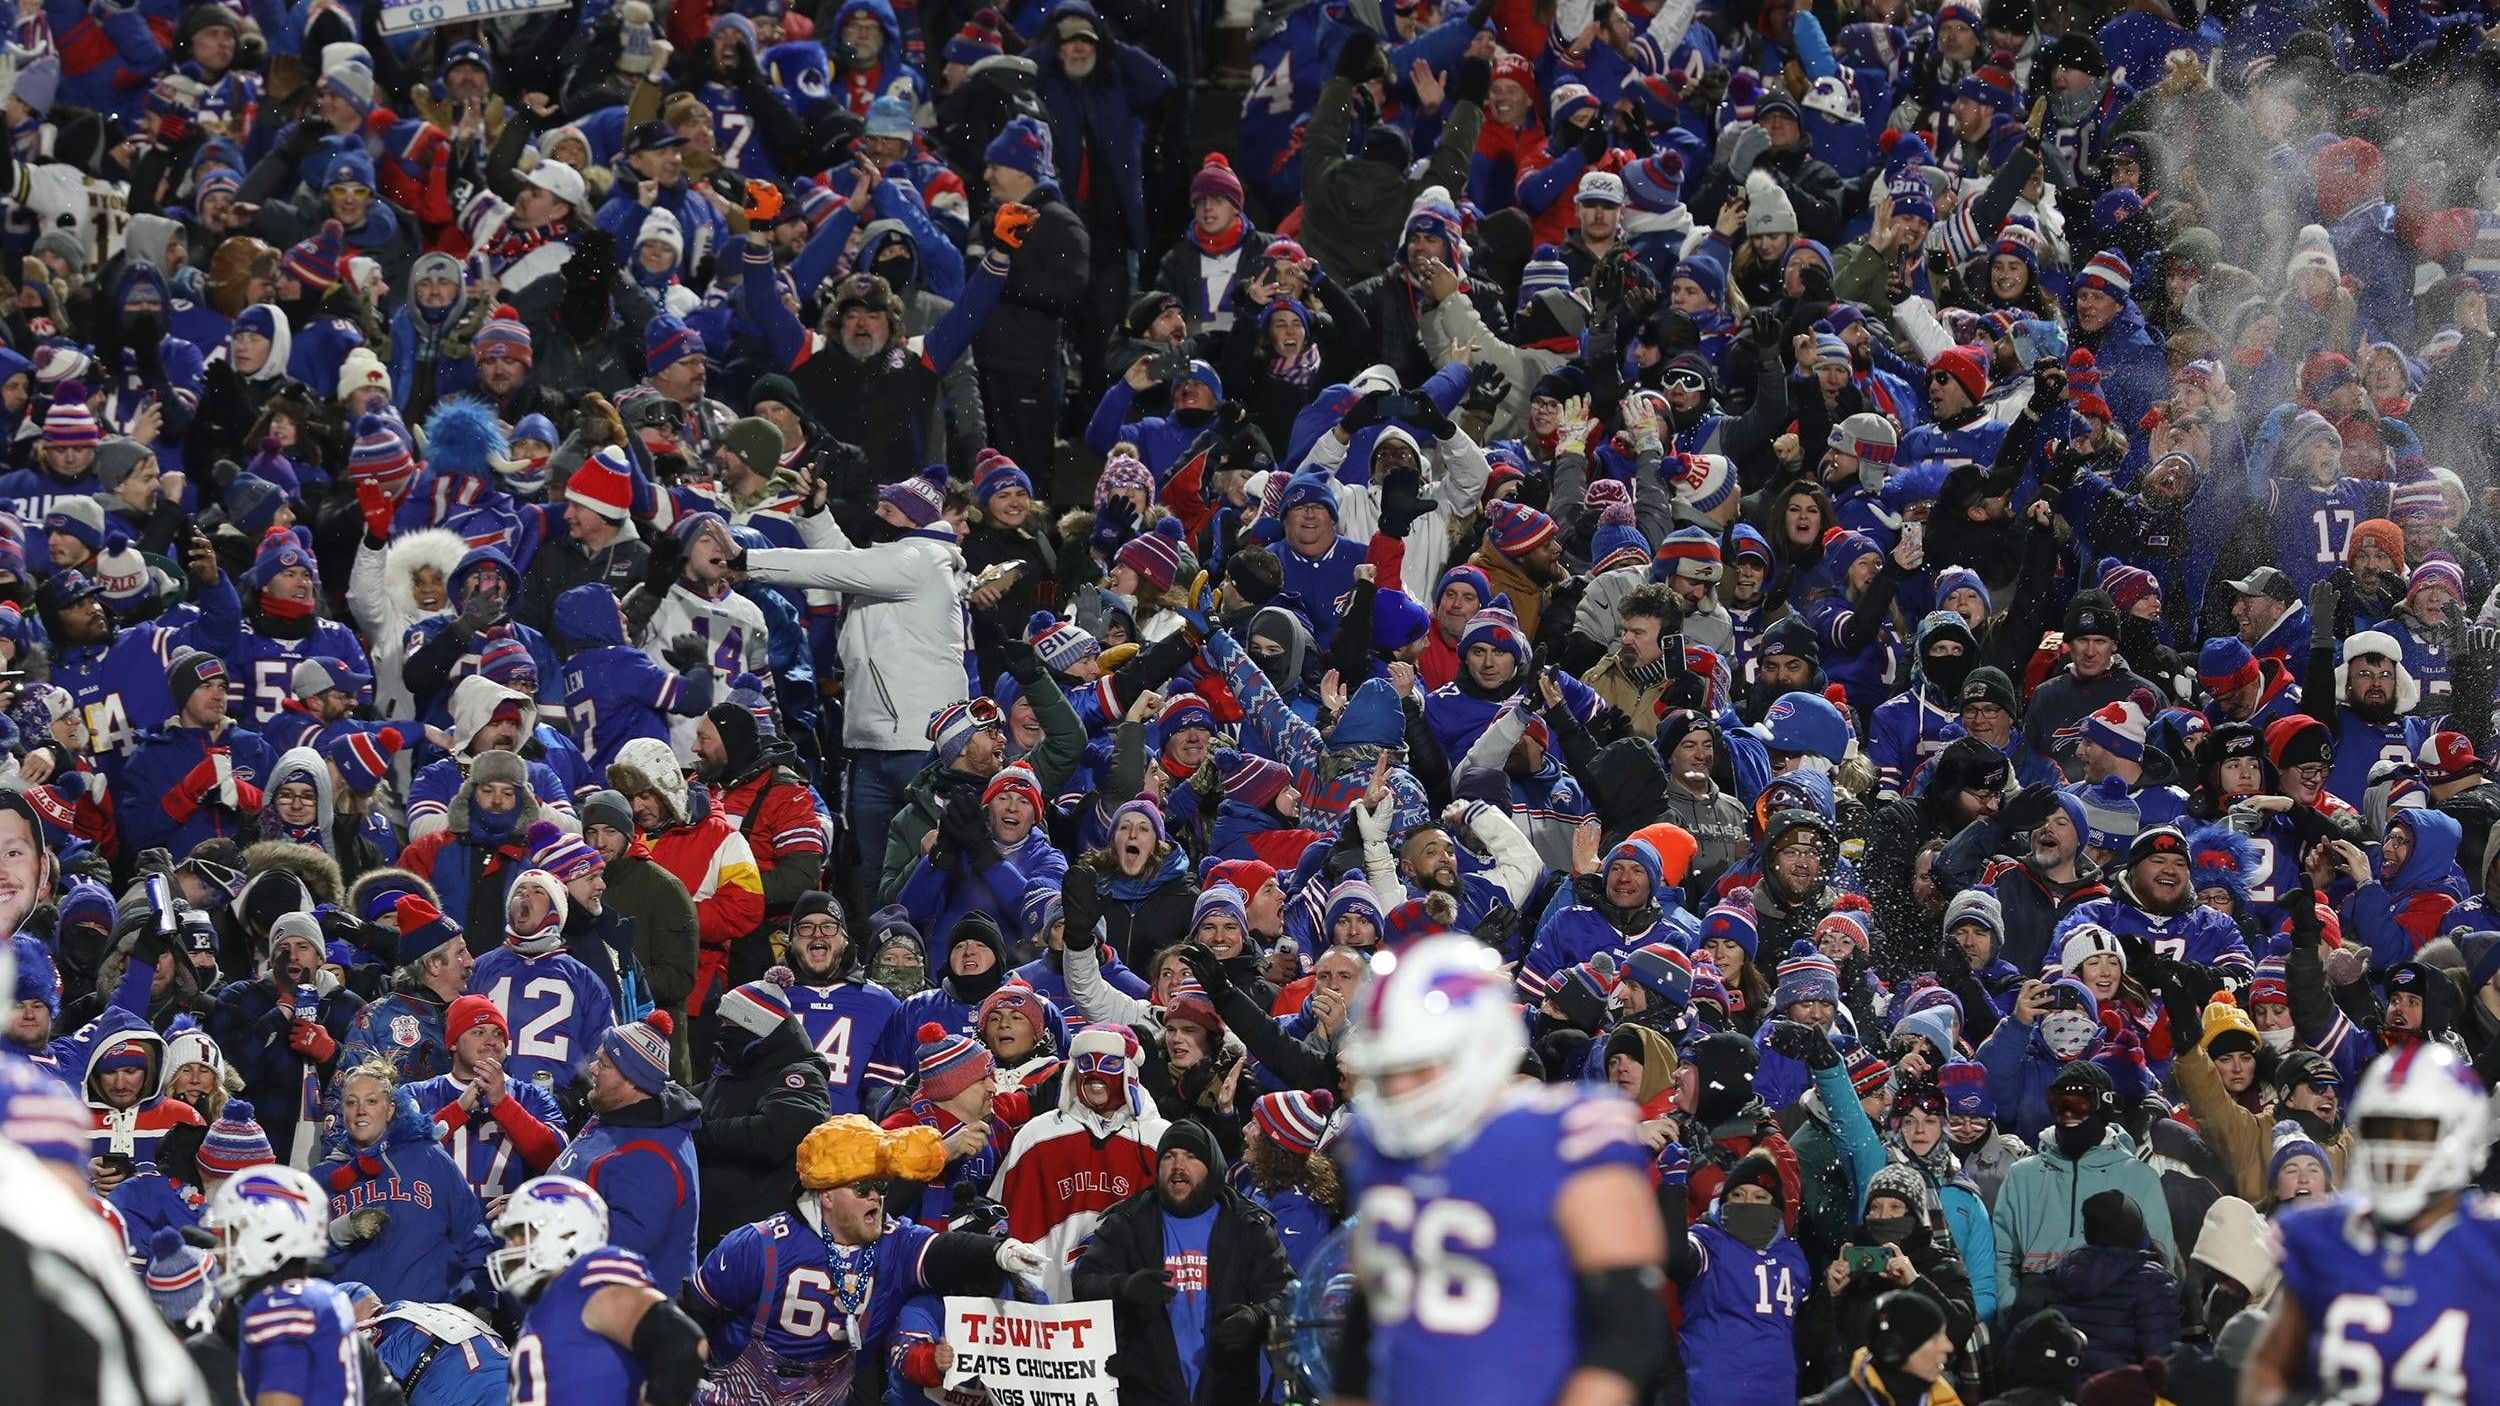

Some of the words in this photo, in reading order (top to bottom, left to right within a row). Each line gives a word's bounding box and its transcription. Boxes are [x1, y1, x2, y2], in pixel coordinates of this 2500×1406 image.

[409, 5, 444, 22] GO
[2312, 509, 2355, 563] 17
[573, 698, 597, 762] 7
[192, 933, 211, 949] E
[295, 1006, 317, 1017] BUD
[486, 975, 578, 1062] 12
[810, 1002, 834, 1010] BILLS
[645, 1042, 669, 1063] BIL
[799, 1012, 851, 1084] 4
[453, 1120, 516, 1198] 17
[331, 1179, 433, 1218] BILLS
[1056, 1171, 1129, 1200] BILLS
[1361, 1184, 1500, 1336] 66
[780, 1267, 873, 1345] 69
[1754, 1264, 1794, 1318] 14
[961, 1313, 1092, 1350] T.SWIFT
[2321, 1292, 2470, 1406] 64
[957, 1353, 1010, 1375] EATS
[1016, 1358, 1096, 1379] CHICKEN
[1030, 1390, 1075, 1406] WITH
[1085, 1391, 1100, 1406] A
